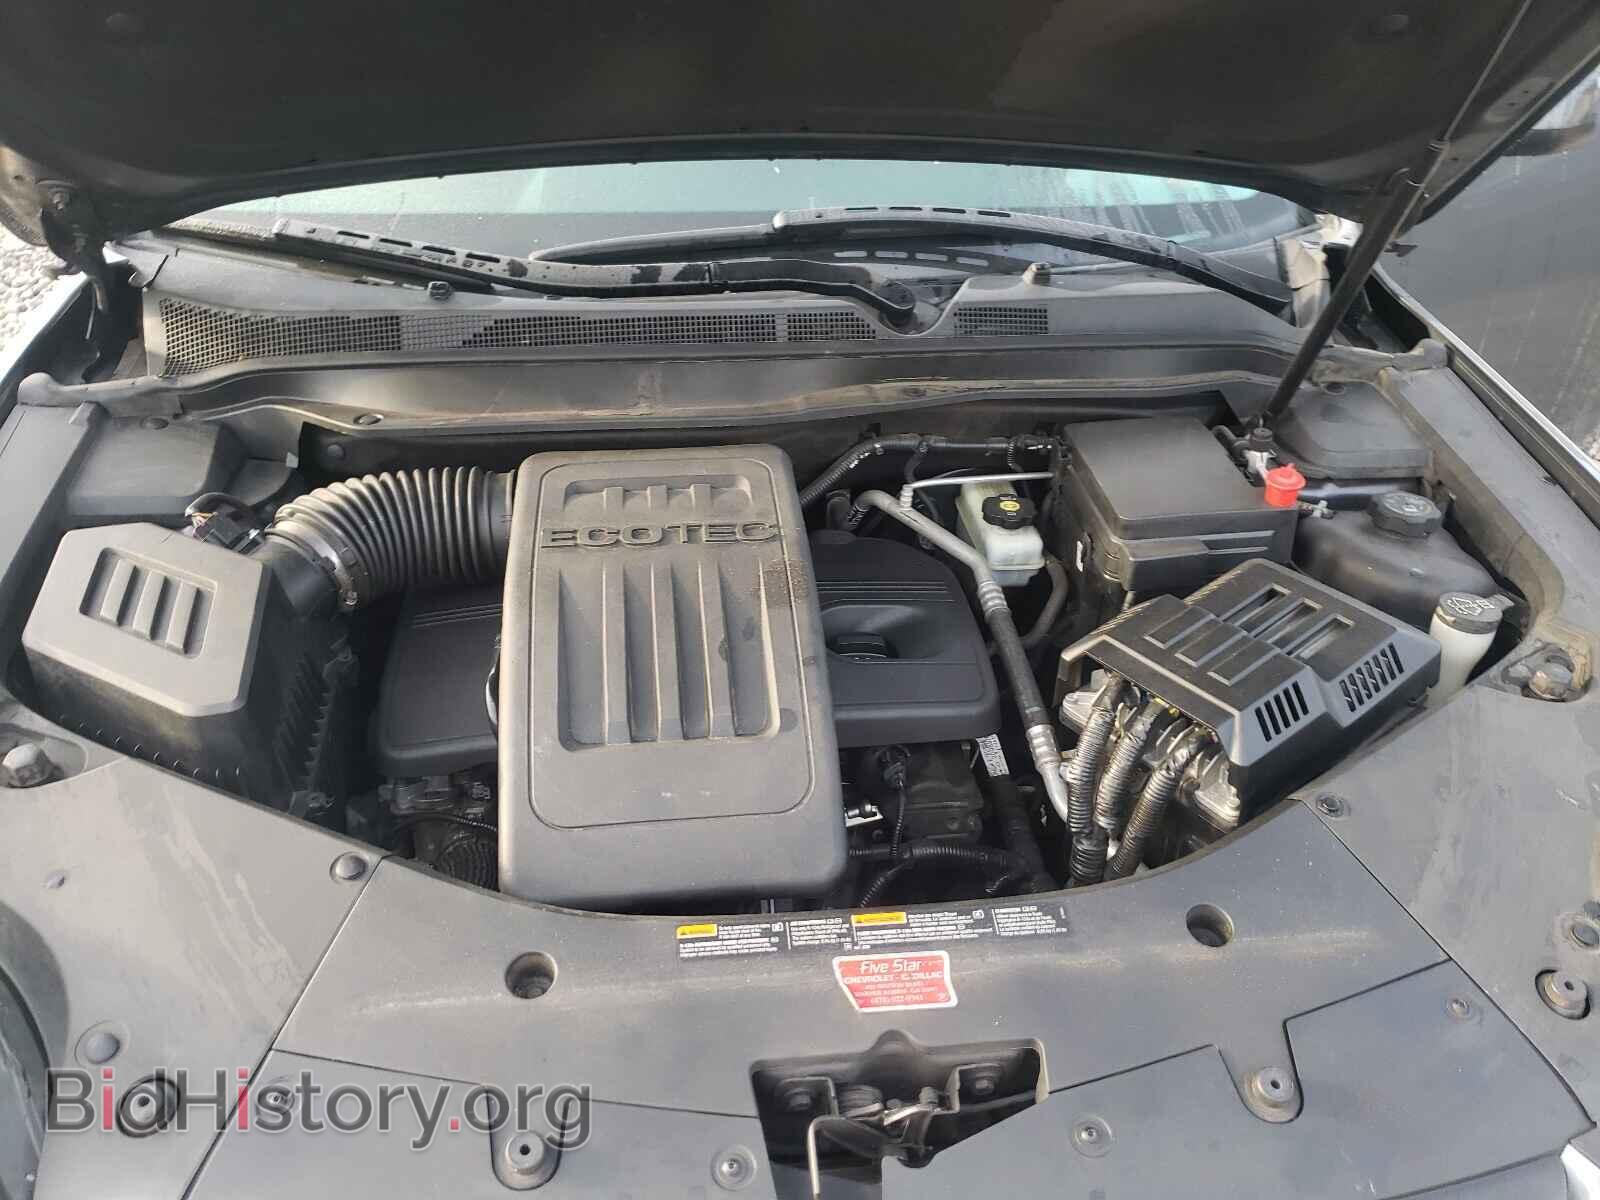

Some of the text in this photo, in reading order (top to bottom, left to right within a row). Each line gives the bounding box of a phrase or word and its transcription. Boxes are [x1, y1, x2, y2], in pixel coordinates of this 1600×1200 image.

[541, 521, 783, 547] ECOTEC
[859, 959, 922, 974] Five Star
[843, 975, 894, 985] CHEVROLET
